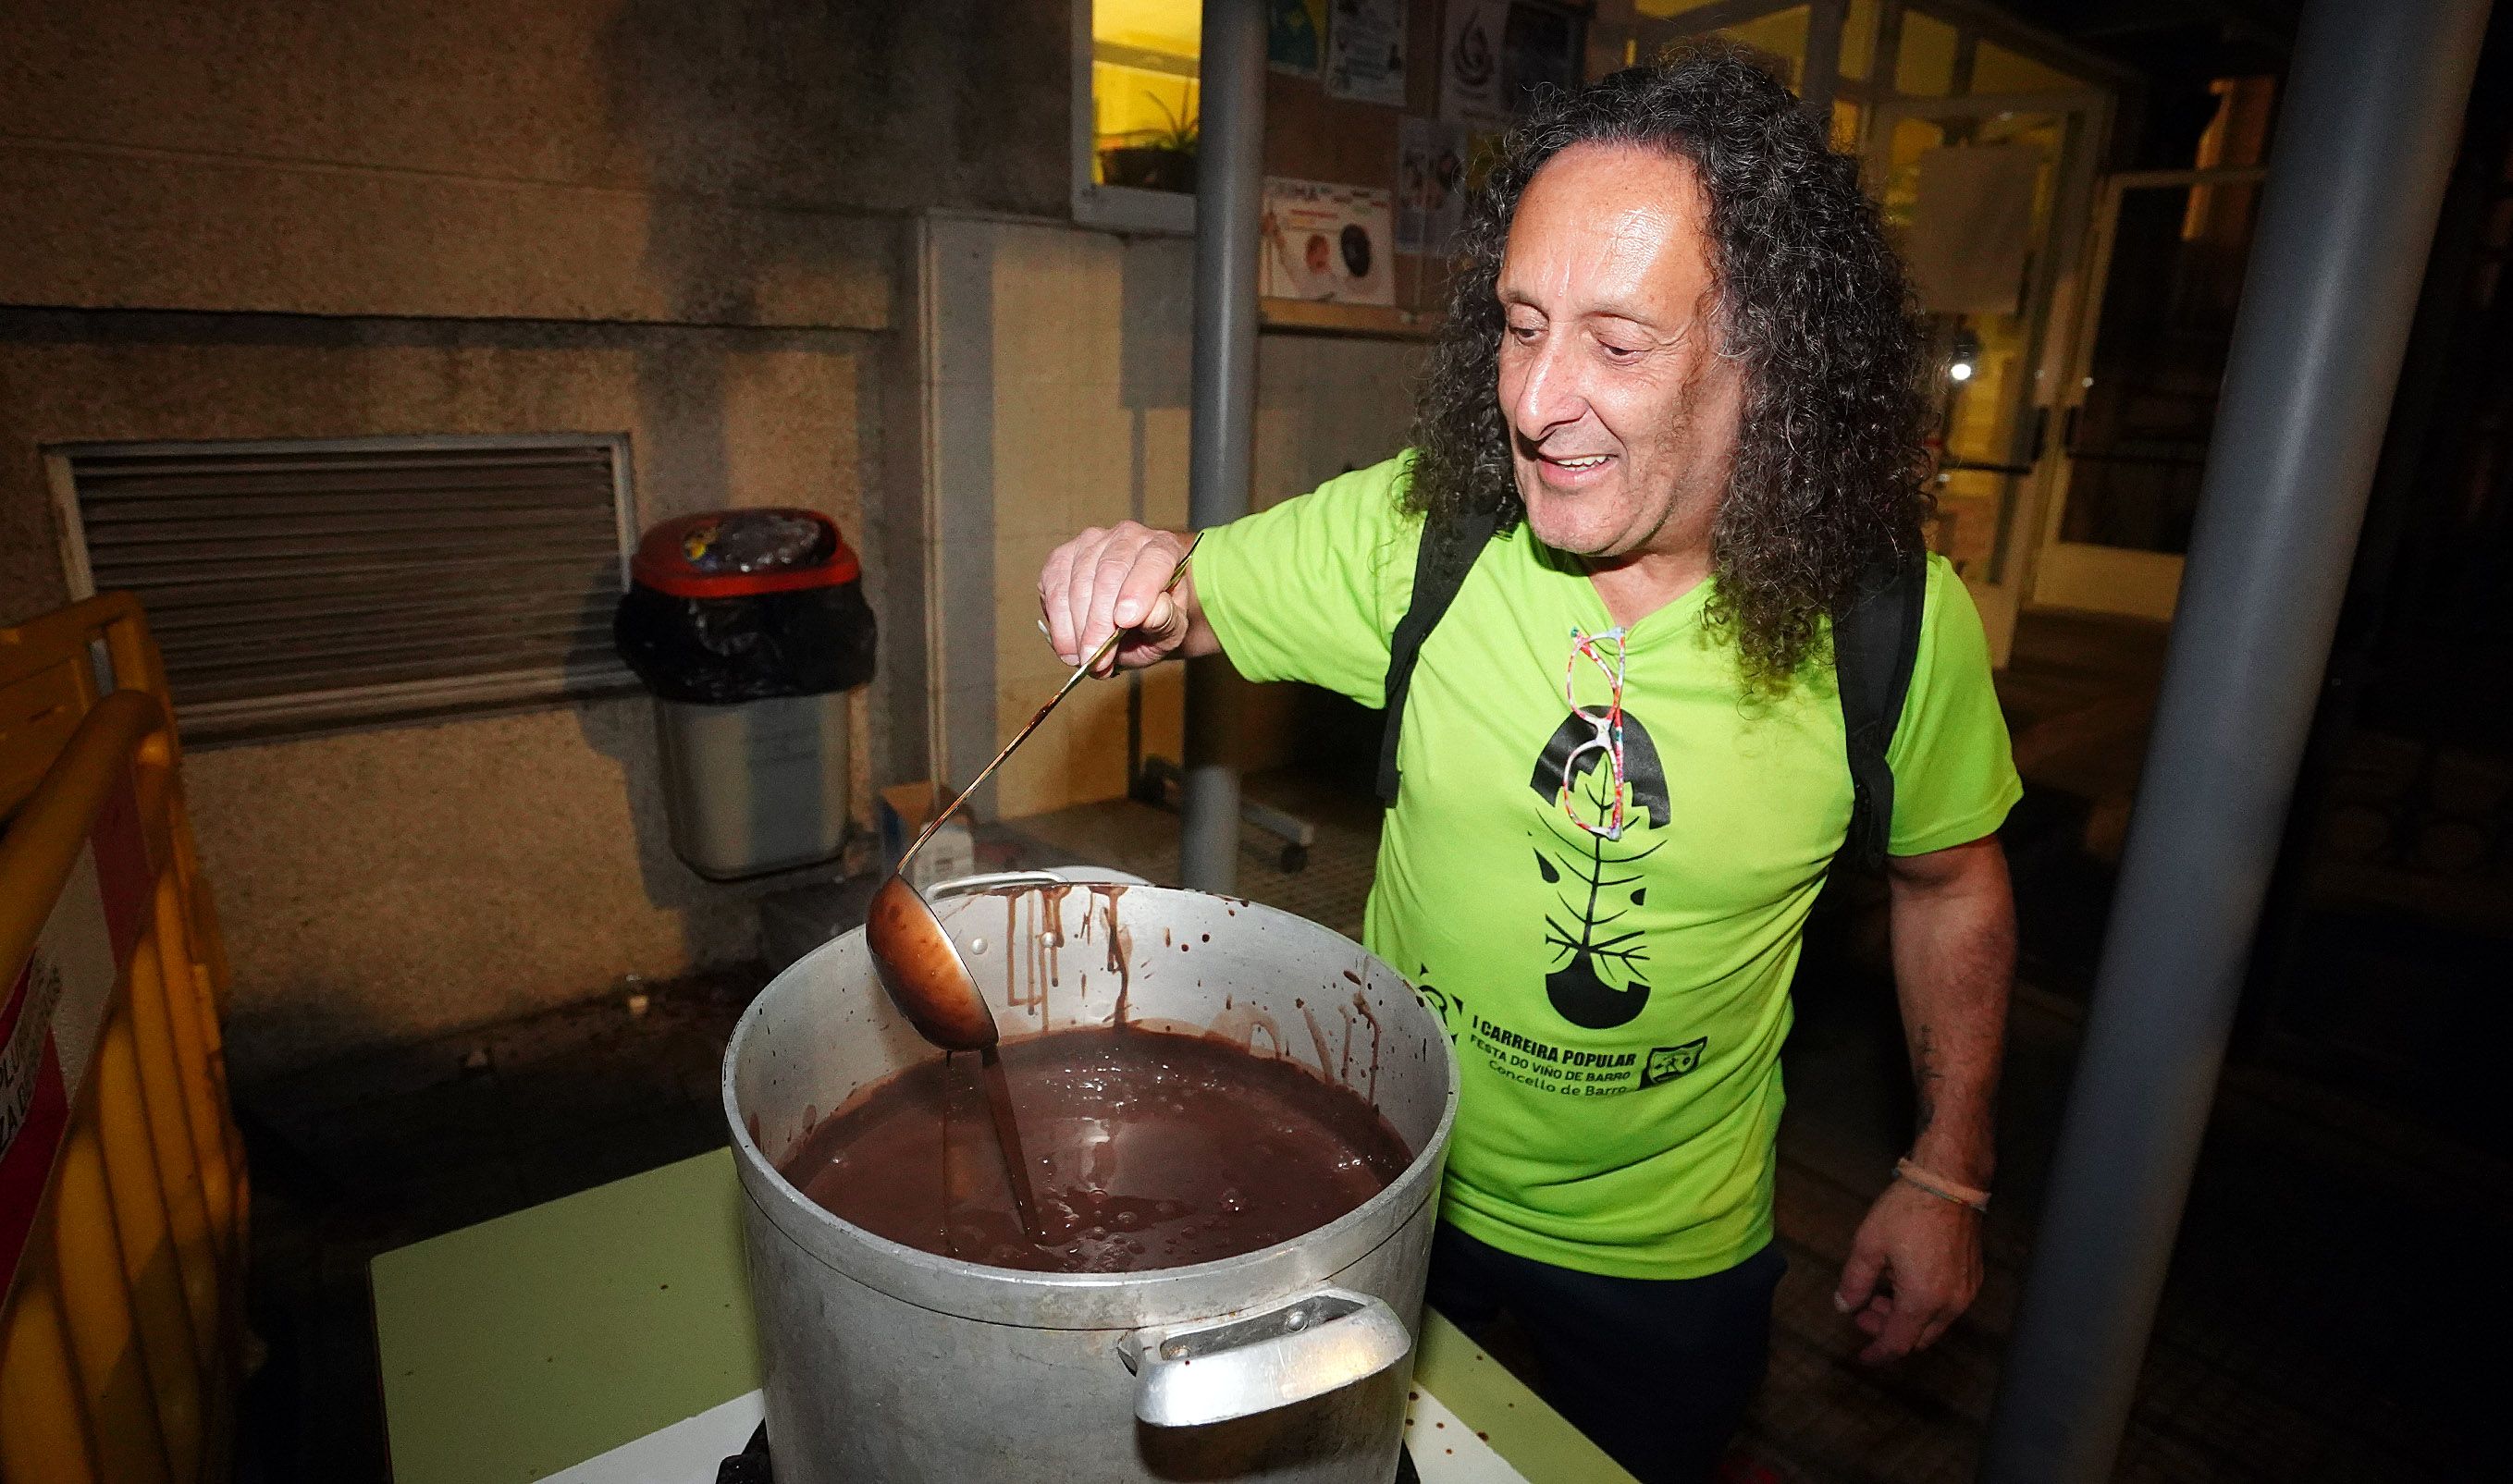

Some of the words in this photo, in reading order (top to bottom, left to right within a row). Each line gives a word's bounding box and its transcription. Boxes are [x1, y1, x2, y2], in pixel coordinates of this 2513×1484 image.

[1471, 1034, 1508, 1062] FESTA
[1510, 1055, 1529, 1070] DO
[1565, 1070, 1584, 1081] DE
[1585, 1071, 1631, 1082] BARRO
[1472, 1015, 1479, 1029] I
[1481, 1021, 1558, 1062] CARREIRA
[1562, 1049, 1637, 1068] POPULAR
[1489, 1060, 1556, 1093] Concello
[1560, 1085, 1581, 1097] de
[1584, 1085, 1627, 1097] Barro
